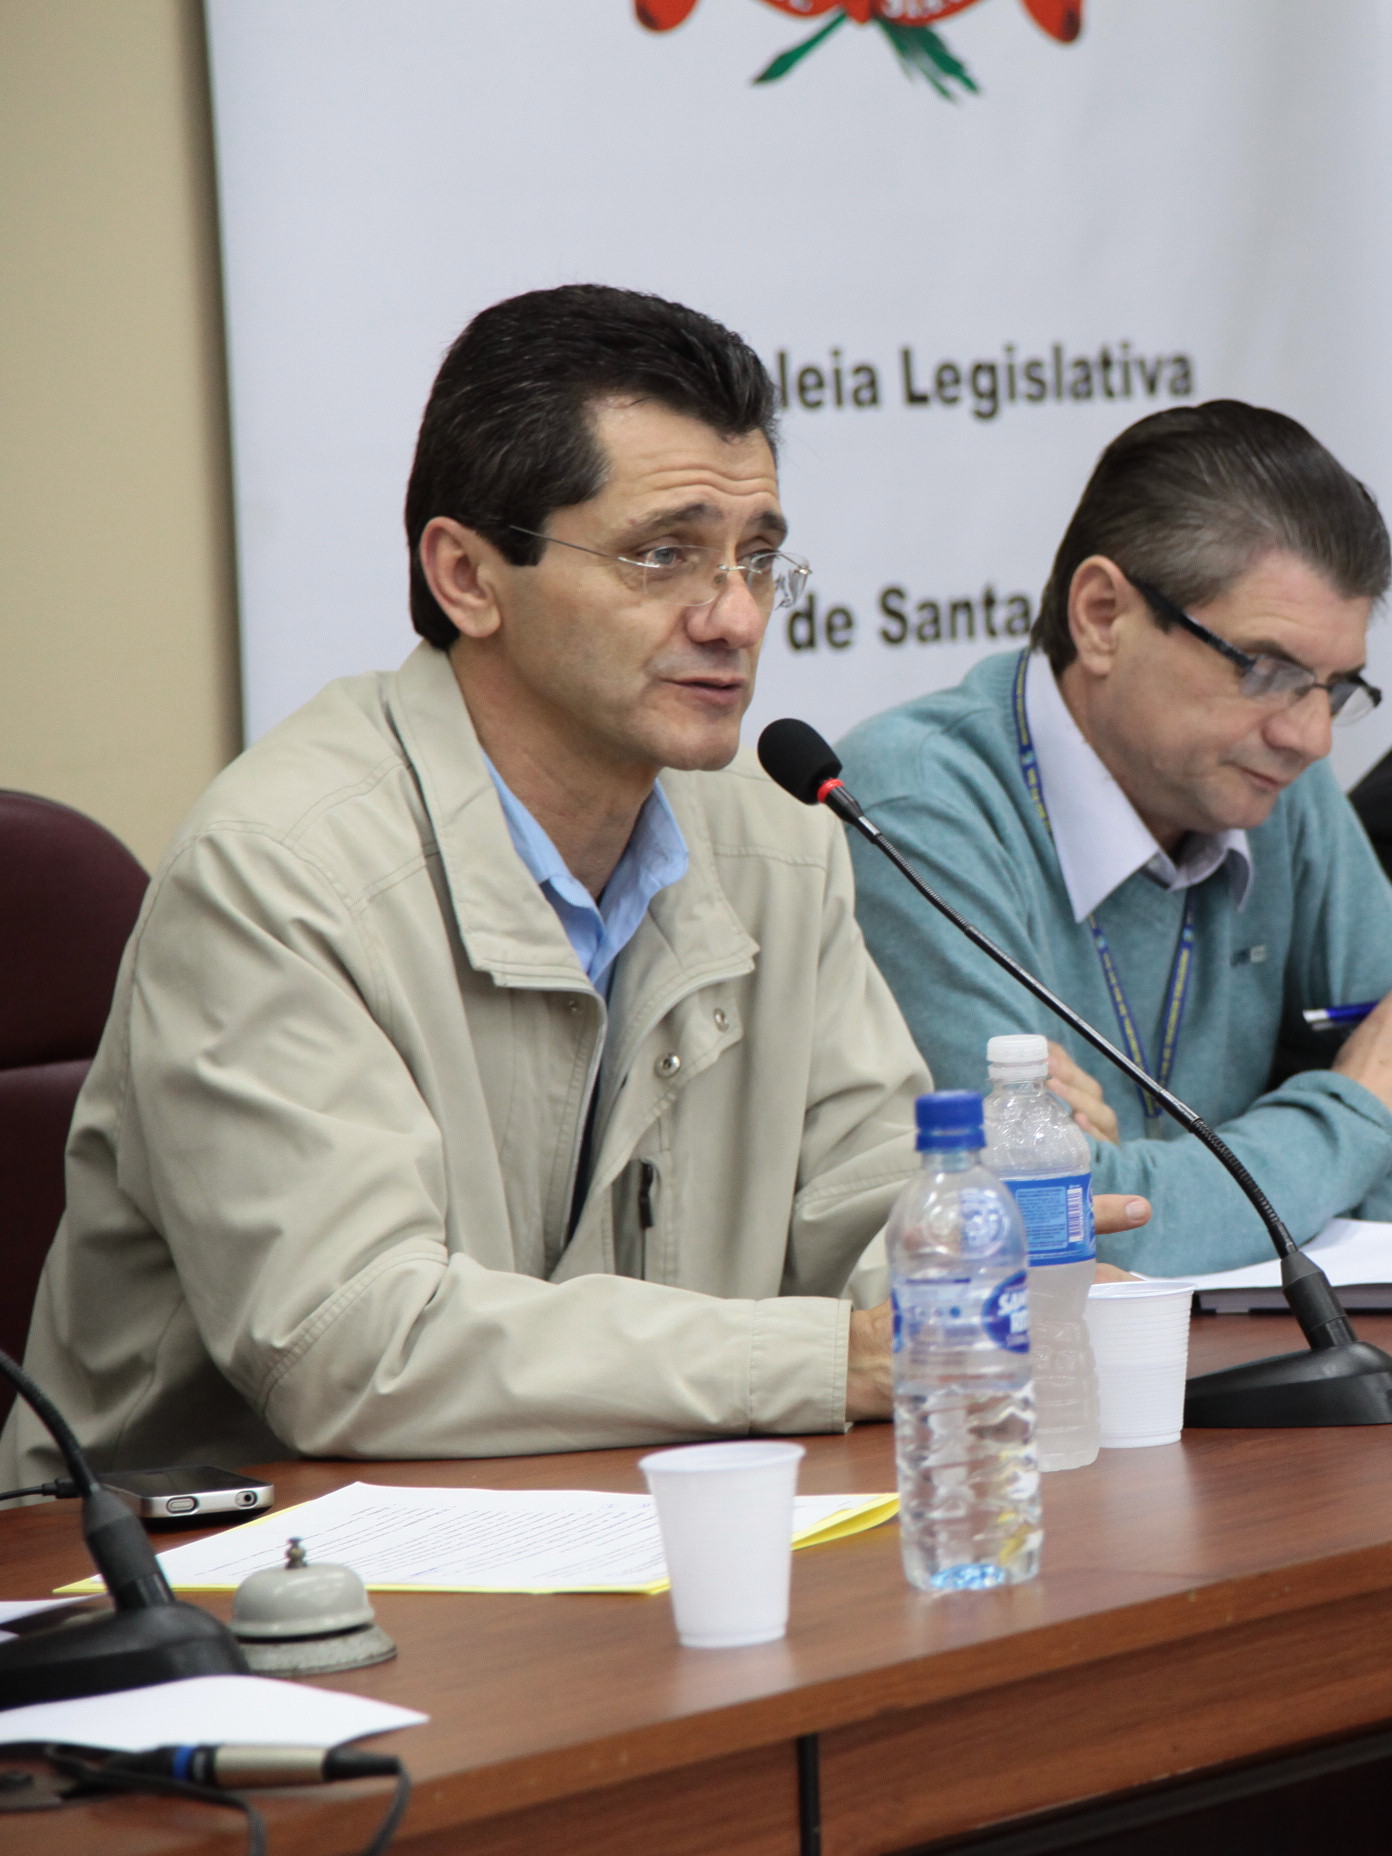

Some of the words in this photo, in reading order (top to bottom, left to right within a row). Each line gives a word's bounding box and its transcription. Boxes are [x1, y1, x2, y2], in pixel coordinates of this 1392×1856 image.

[777, 349, 880, 410] leia
[902, 343, 1194, 421] Legislativa
[786, 593, 854, 652] de
[879, 585, 1033, 646] Santa
